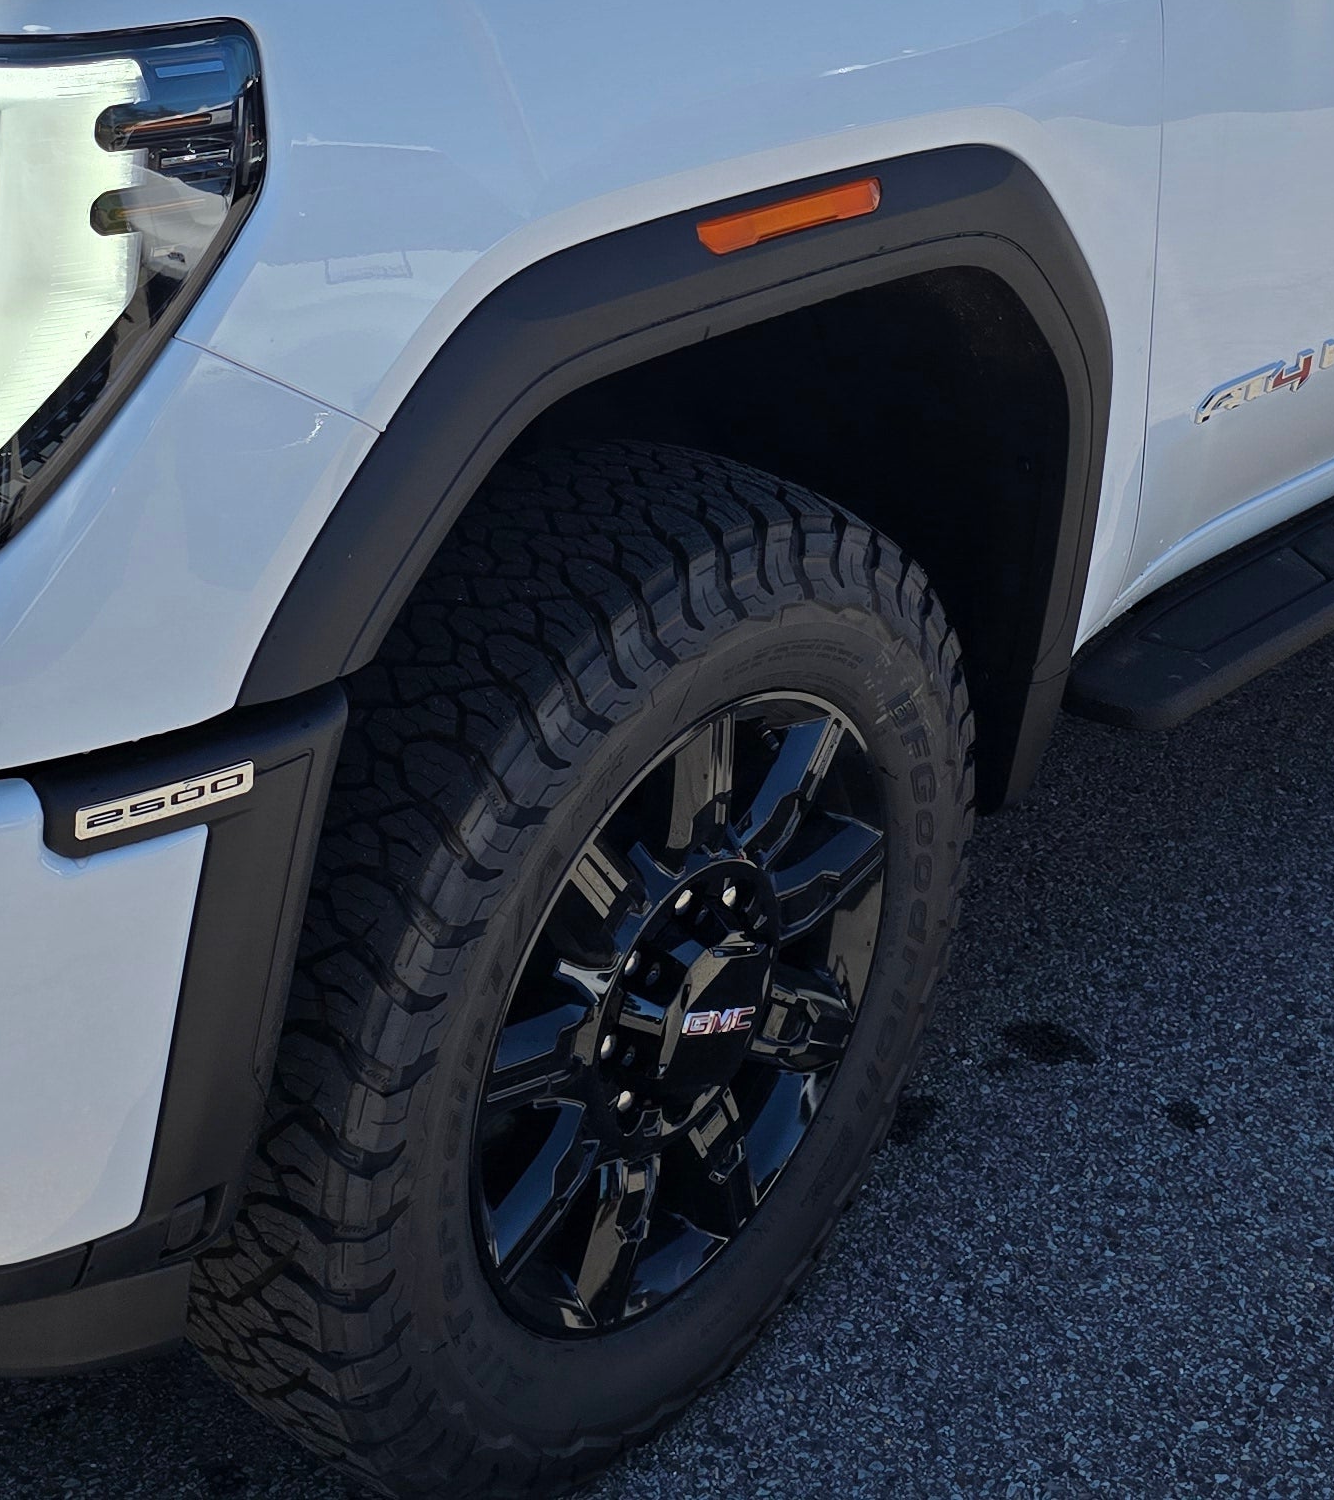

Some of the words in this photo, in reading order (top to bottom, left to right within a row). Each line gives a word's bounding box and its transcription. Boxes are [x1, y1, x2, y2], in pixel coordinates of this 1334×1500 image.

[1193, 348, 1315, 425] AT4
[86, 773, 244, 830] 2500
[682, 1005, 756, 1035] GMC
